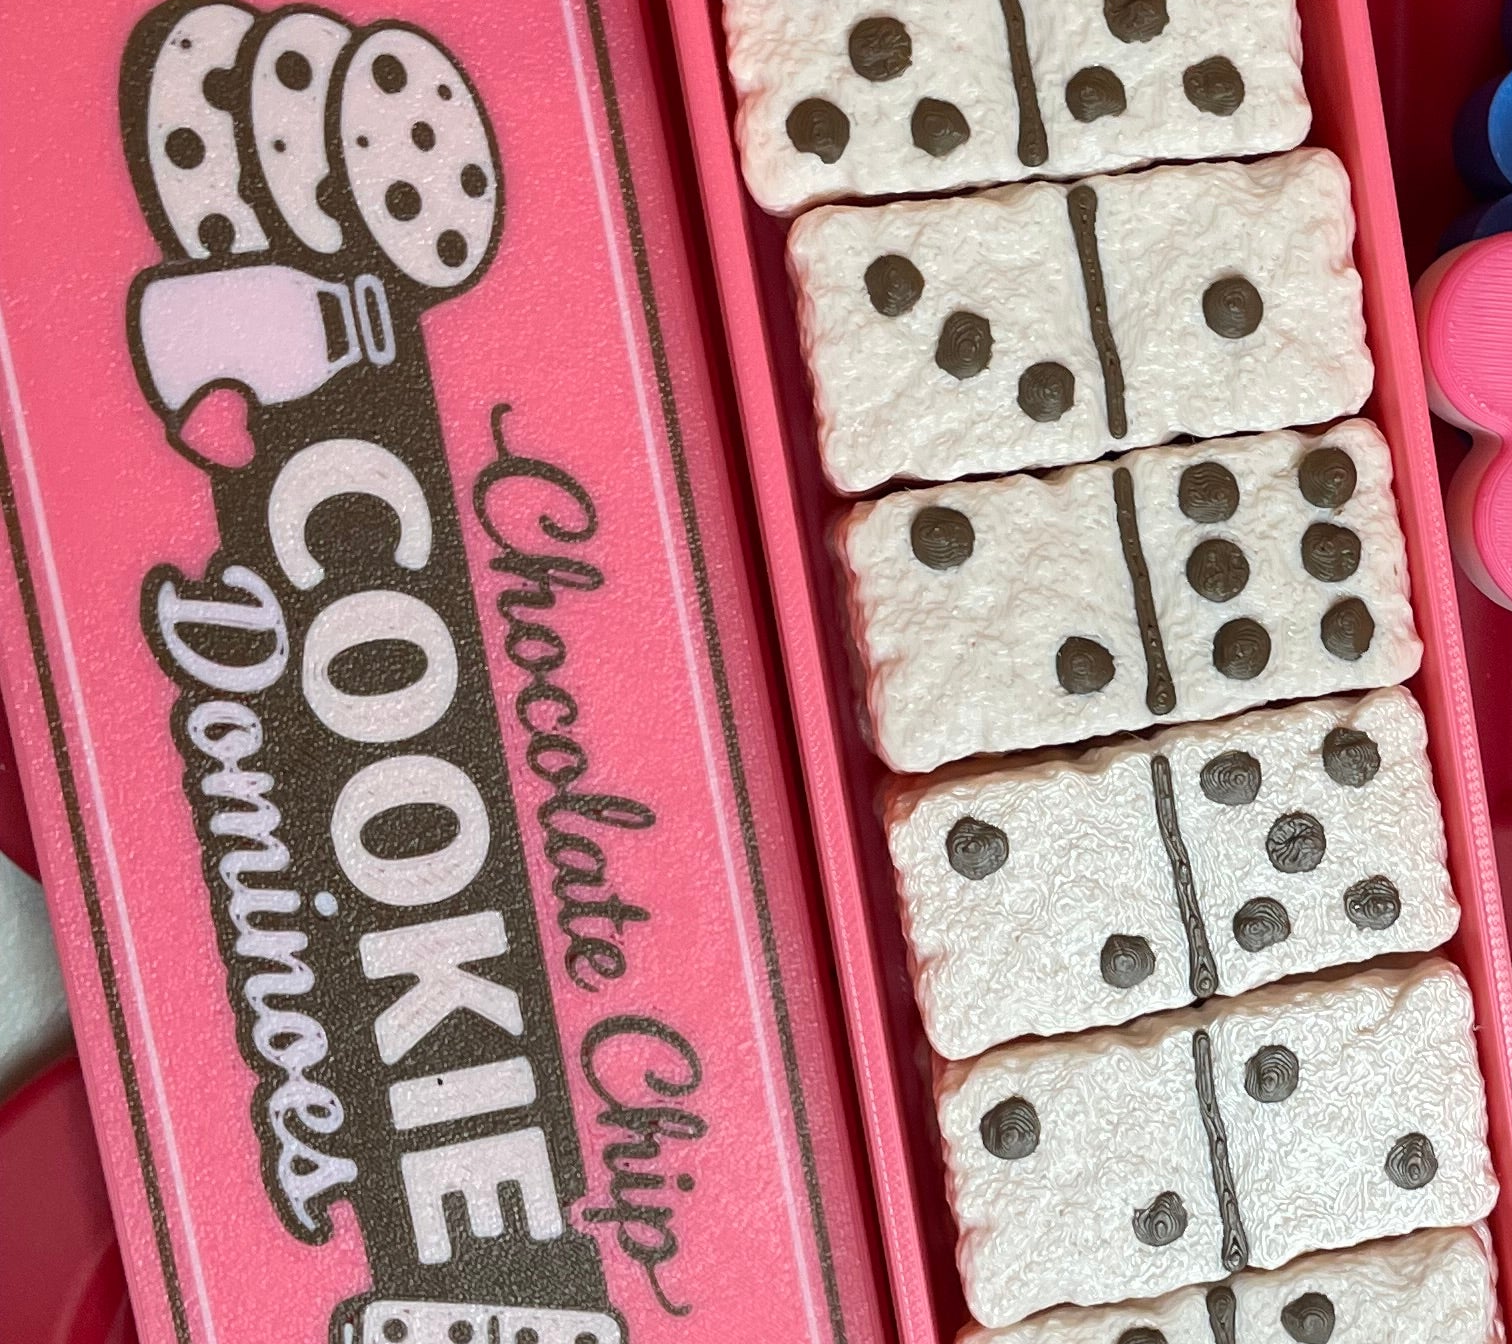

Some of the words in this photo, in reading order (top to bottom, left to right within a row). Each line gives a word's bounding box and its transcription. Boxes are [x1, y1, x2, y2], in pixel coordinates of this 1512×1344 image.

[157, 565, 359, 1231] Dominoes
[268, 438, 563, 1265] COOKIE
[473, 403, 656, 994] Chocolate
[581, 1014, 708, 1316] Chip
